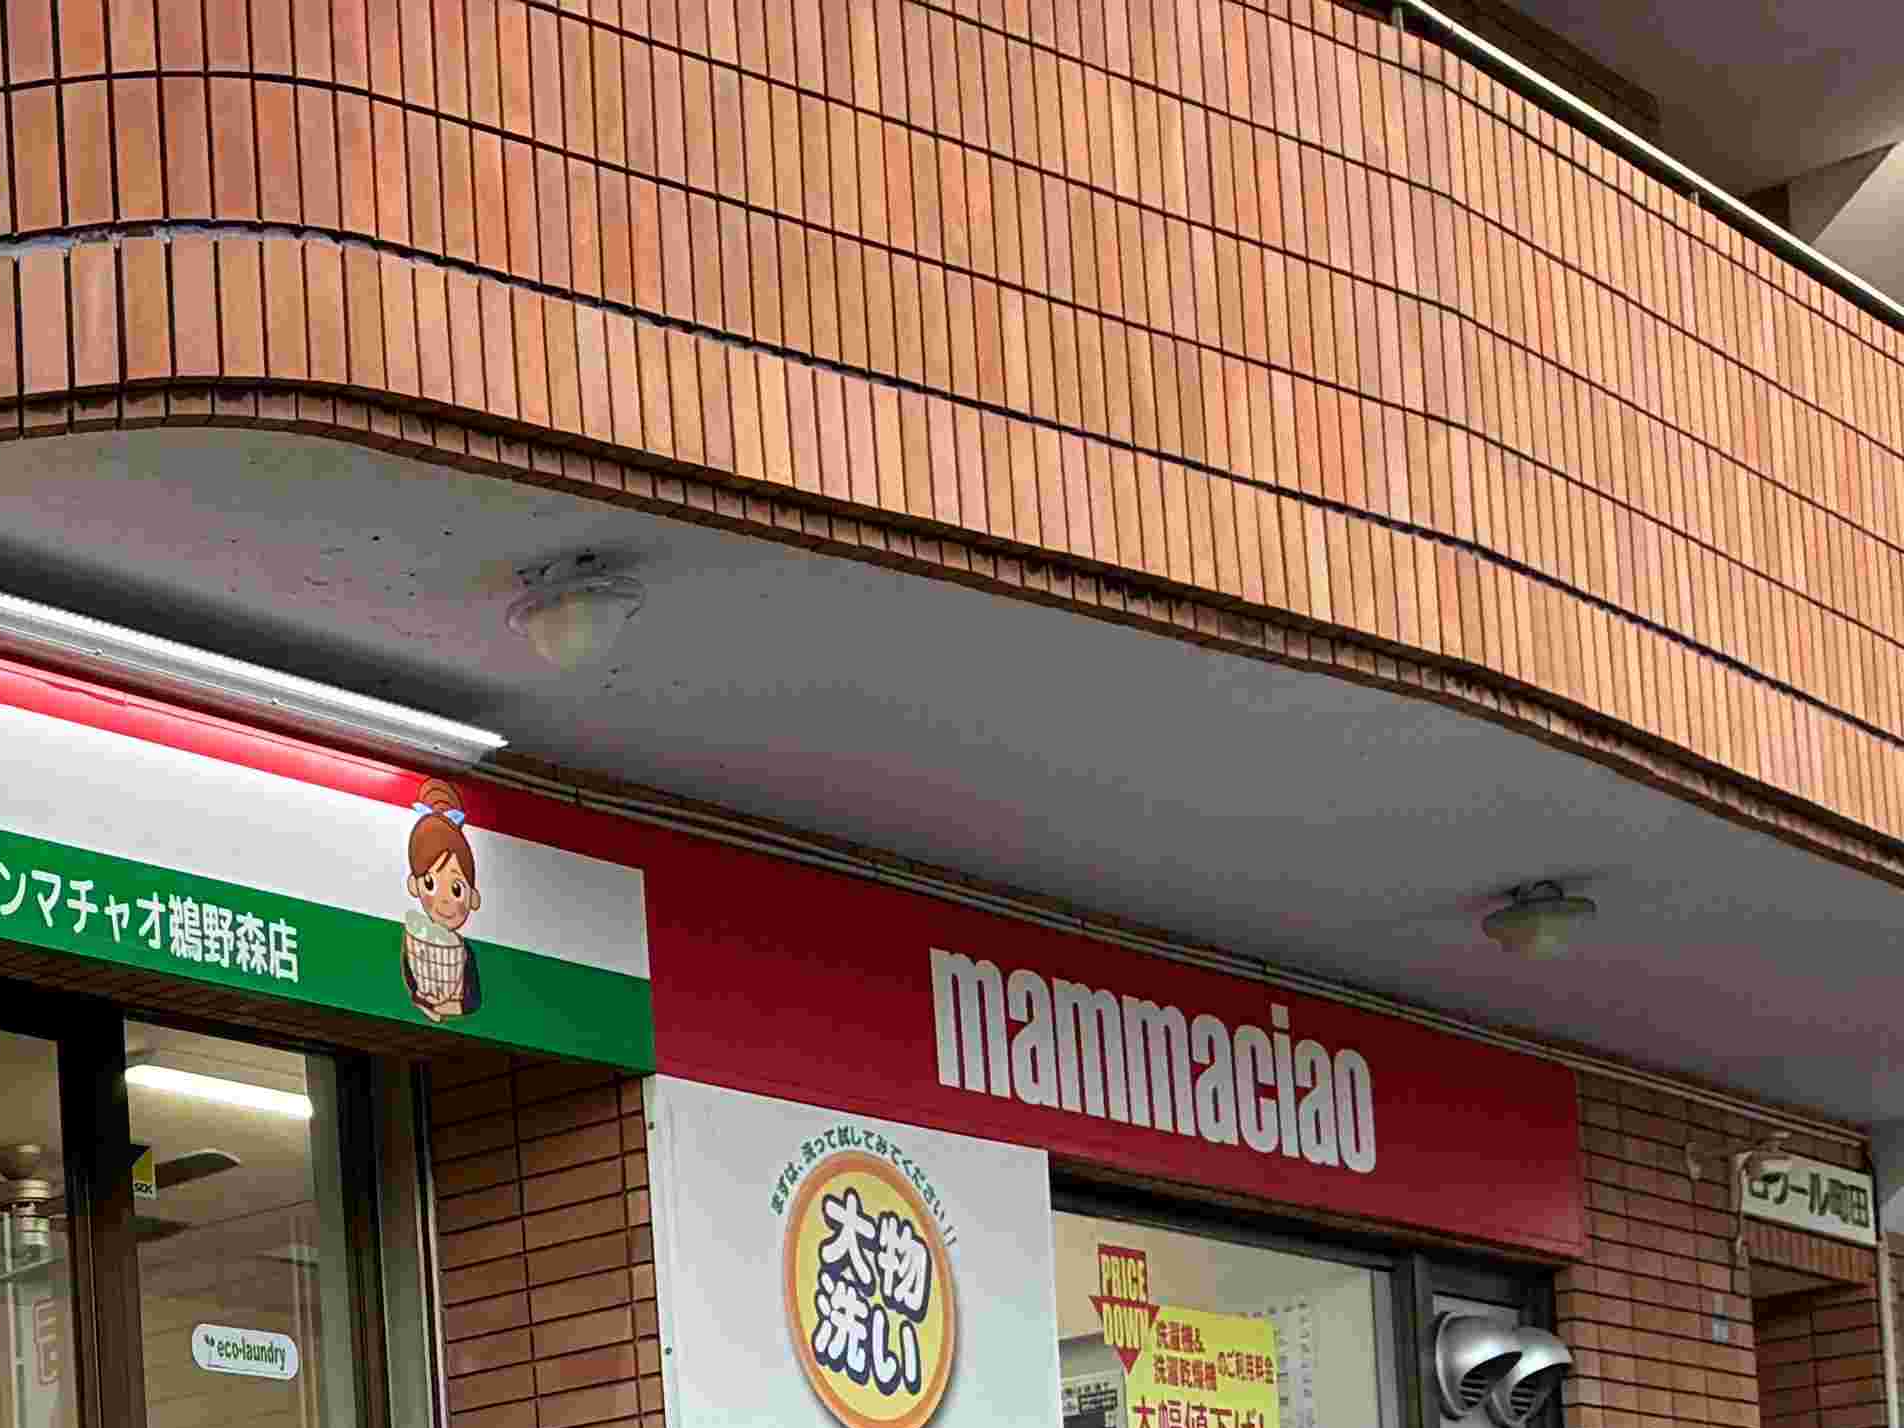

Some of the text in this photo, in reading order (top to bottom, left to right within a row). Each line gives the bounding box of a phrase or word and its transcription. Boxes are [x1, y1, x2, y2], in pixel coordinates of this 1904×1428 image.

[929, 946, 1376, 1174] mammaciao
[819, 1187, 932, 1323] 大物
[216, 1336, 285, 1371] eco-laundry
[812, 1269, 923, 1396] 洗い
